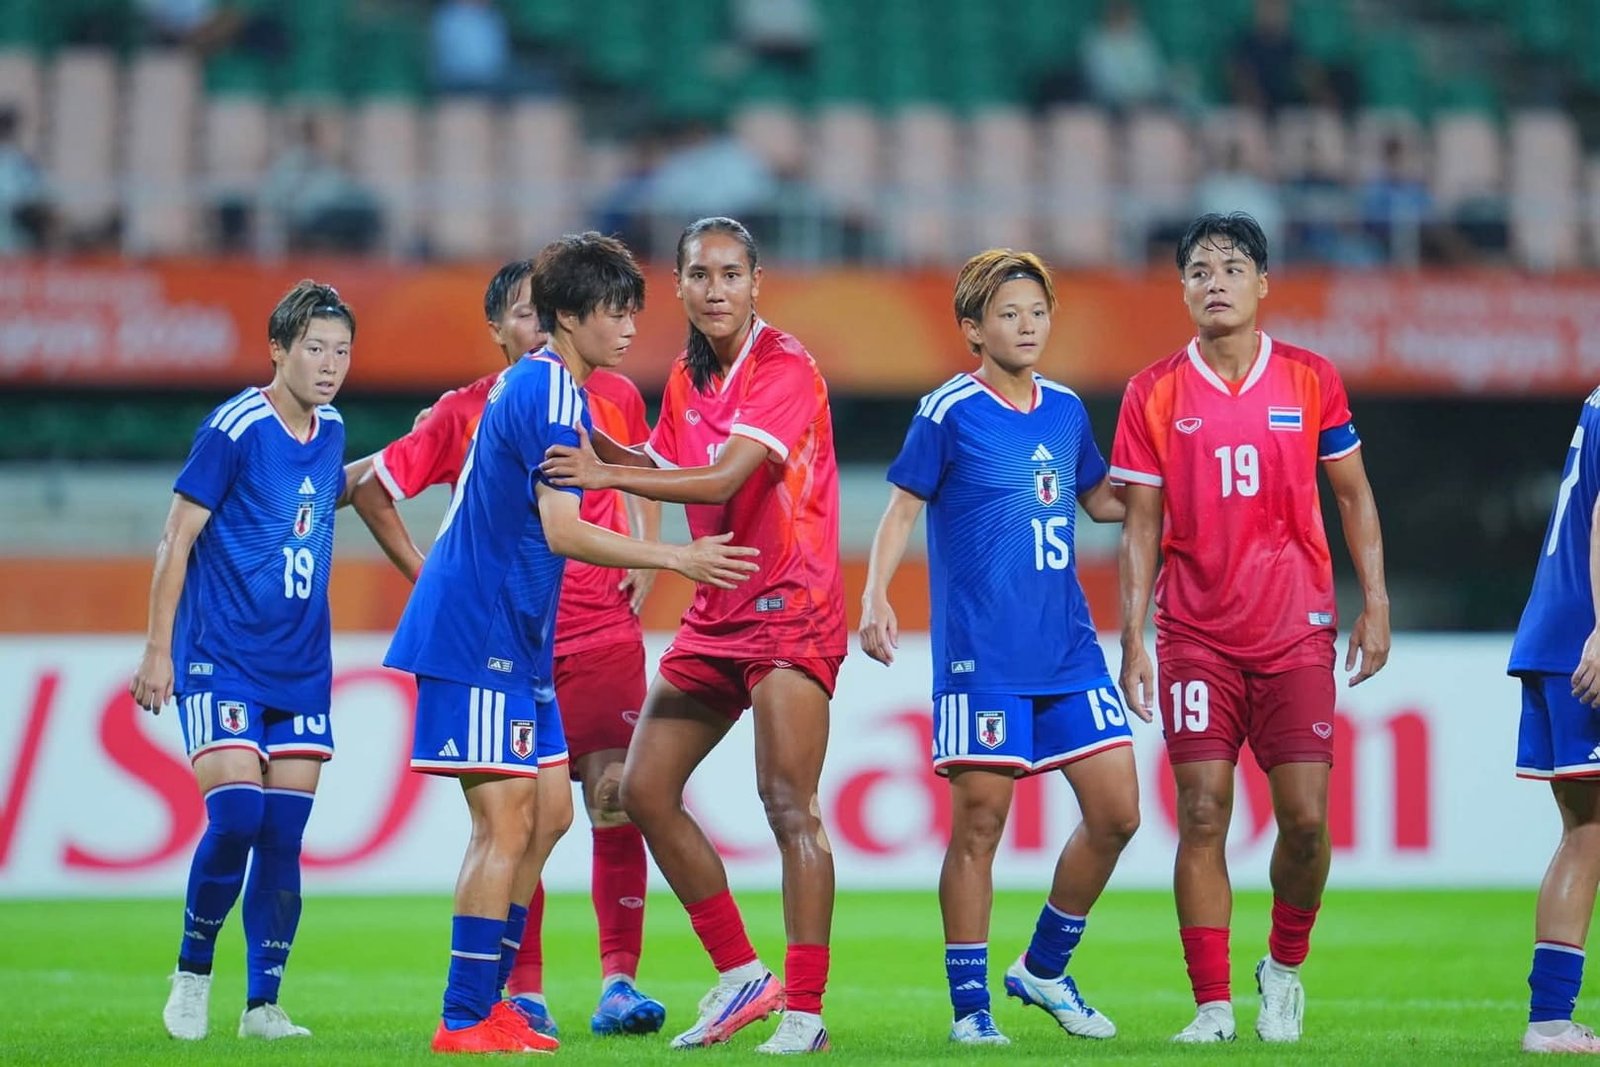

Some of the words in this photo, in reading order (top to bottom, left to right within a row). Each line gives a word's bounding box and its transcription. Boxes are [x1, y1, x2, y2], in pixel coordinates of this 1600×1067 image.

[1215, 444, 1260, 498] 19
[1031, 516, 1069, 571] 15
[283, 547, 315, 599] 19
[1087, 687, 1126, 731] 15
[1170, 680, 1209, 734] 19
